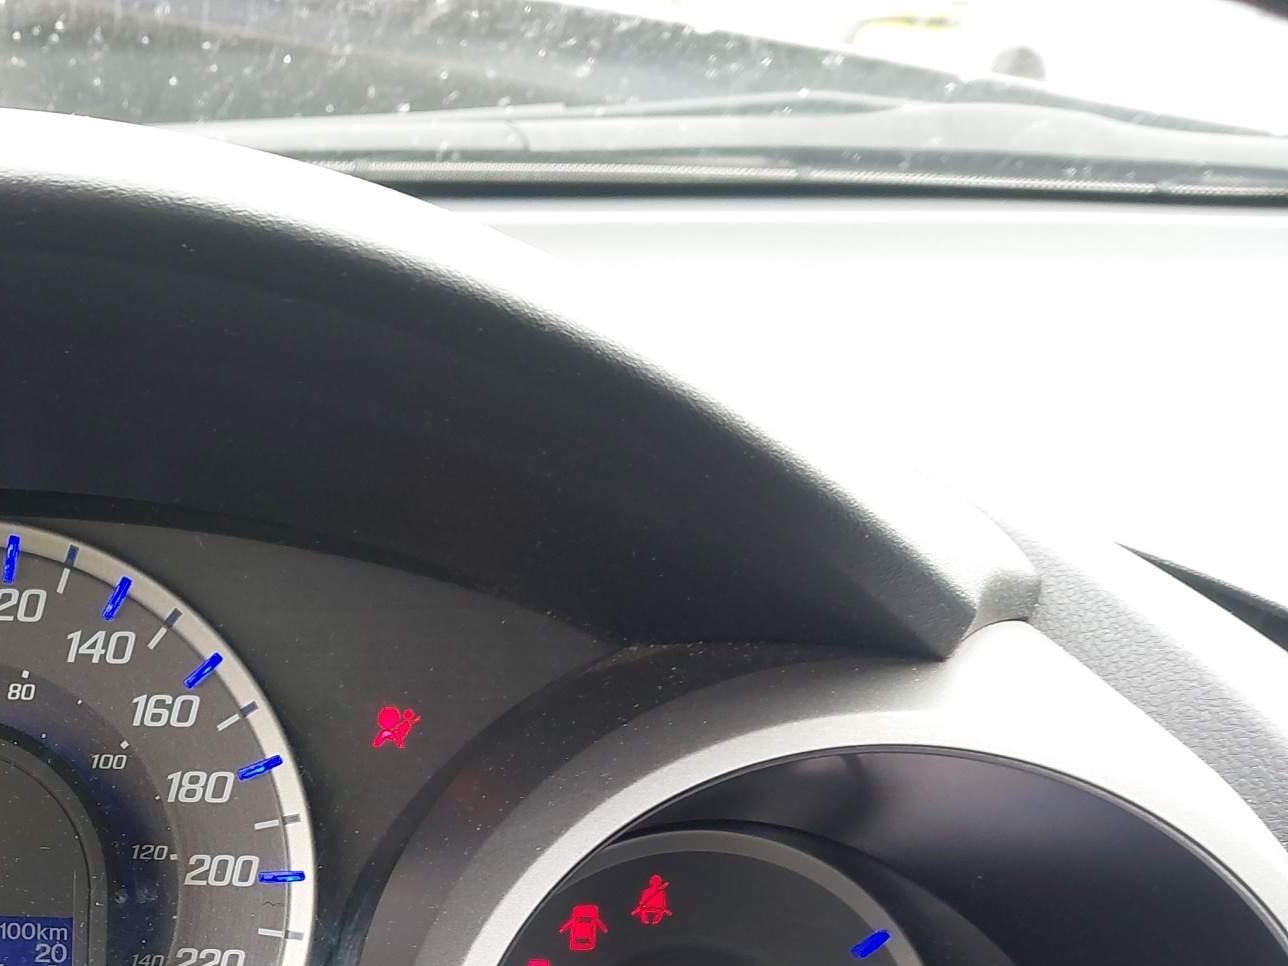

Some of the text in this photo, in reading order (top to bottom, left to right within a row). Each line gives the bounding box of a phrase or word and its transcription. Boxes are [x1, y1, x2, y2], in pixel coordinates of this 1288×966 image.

[66, 631, 135, 664] 140
[7, 683, 35, 701] 80
[131, 695, 200, 728] 160
[90, 754, 127, 770] 100
[166, 771, 233, 803] 180
[132, 844, 169, 860] 120
[184, 855, 260, 888] 200
[35, 944, 67, 963] 20
